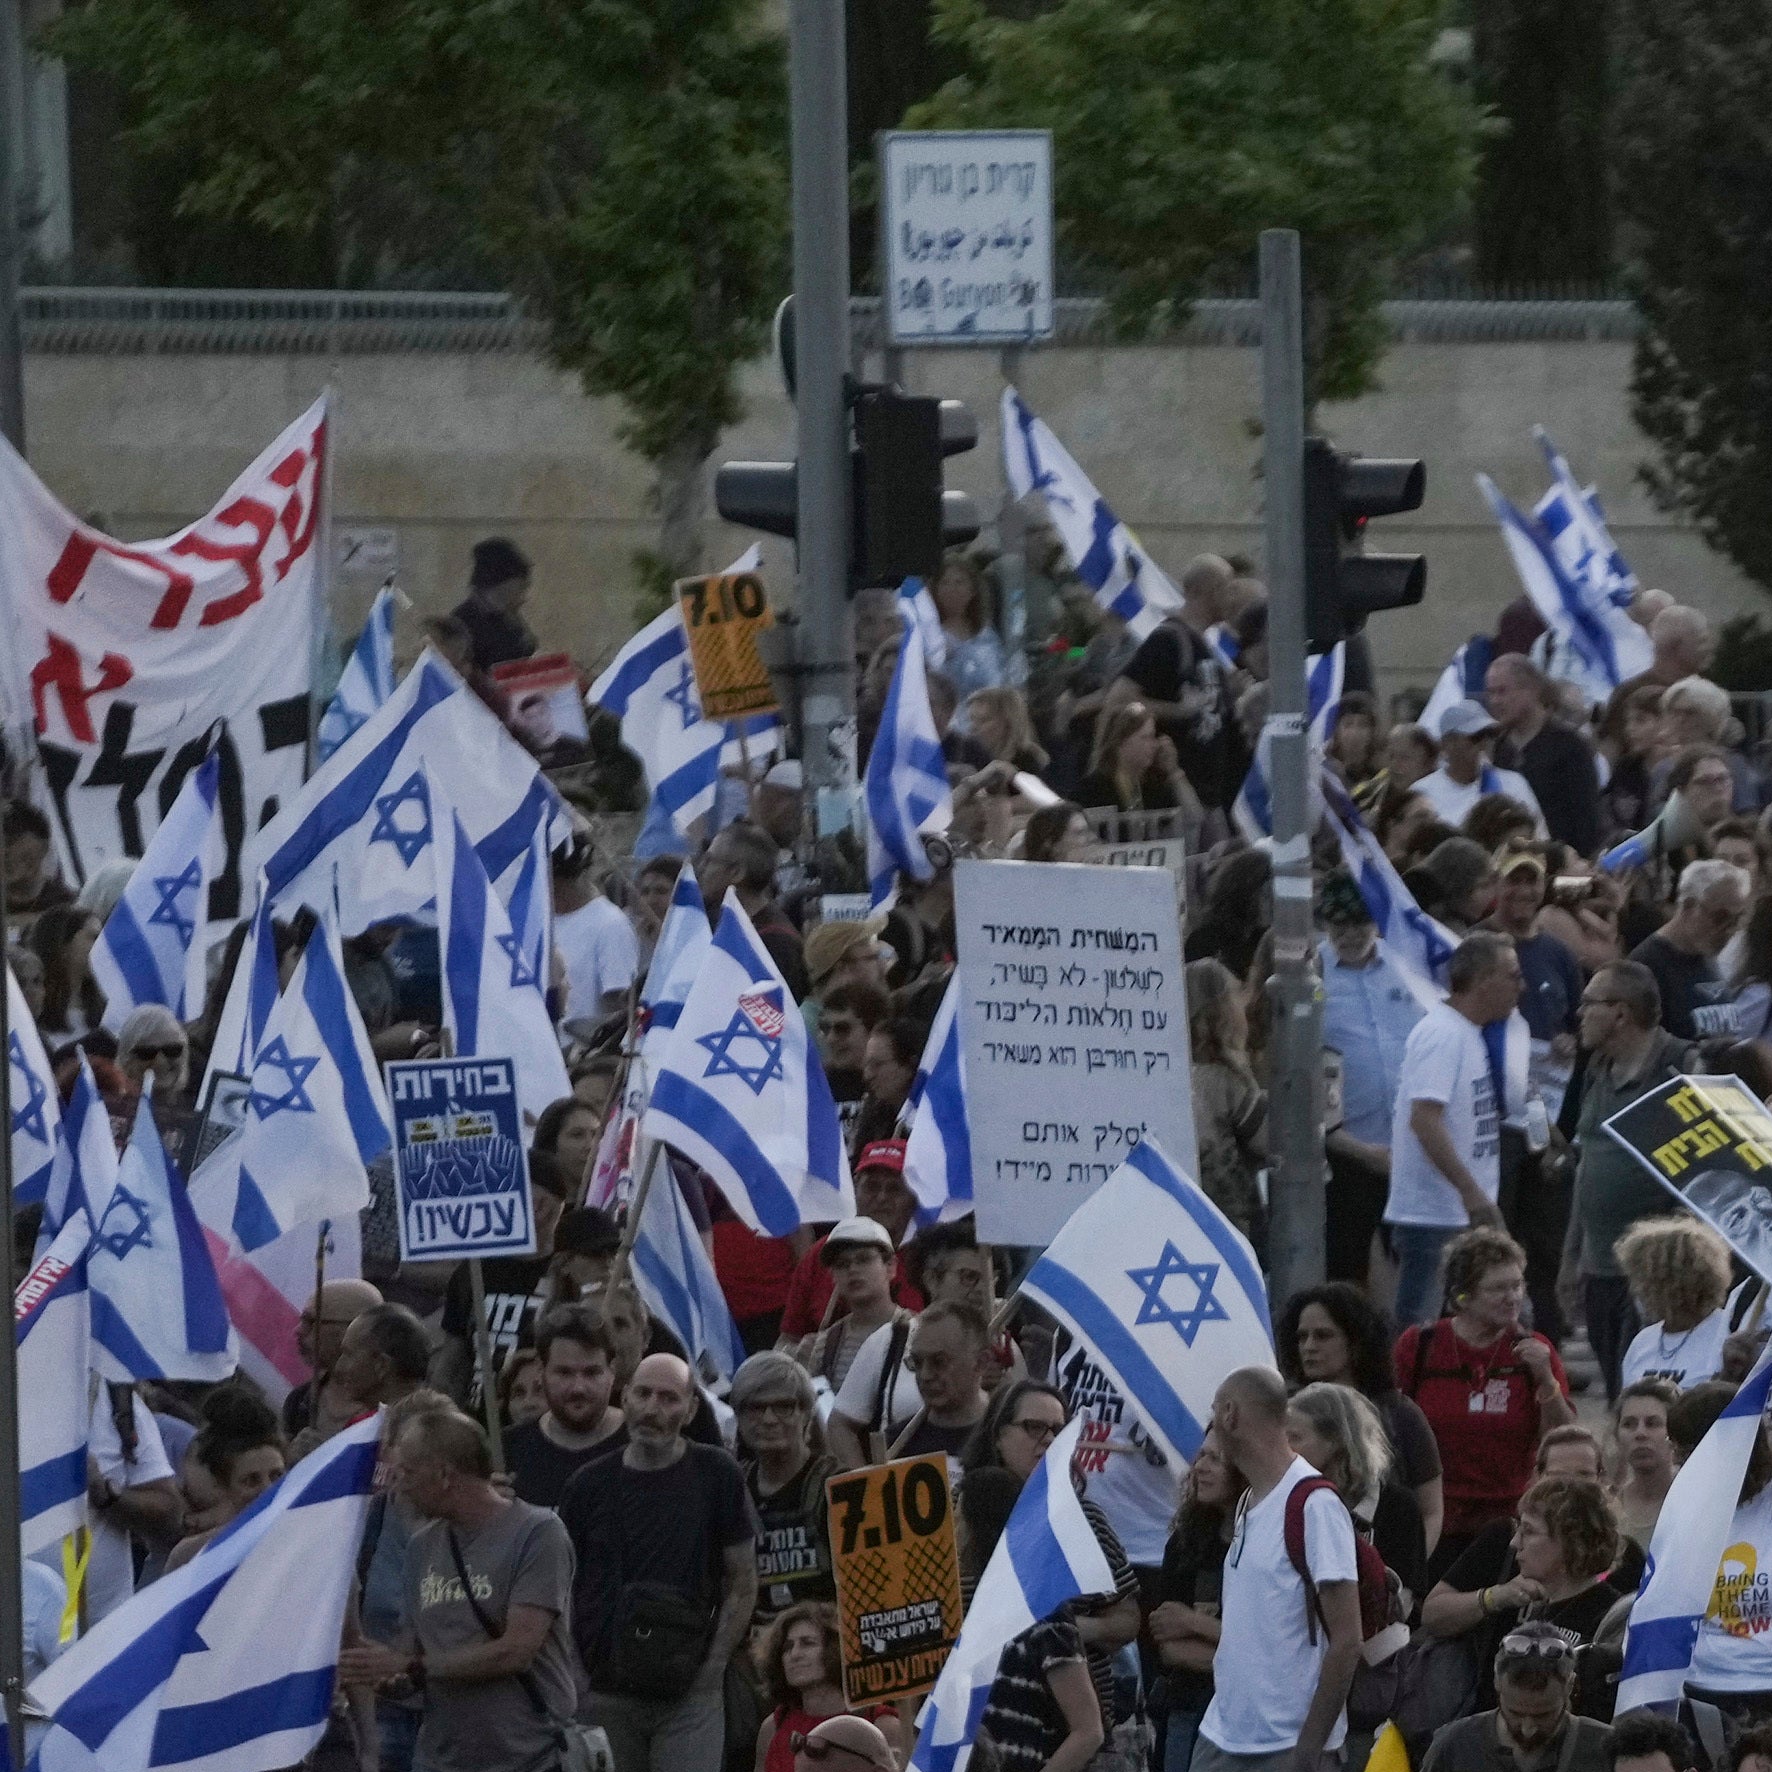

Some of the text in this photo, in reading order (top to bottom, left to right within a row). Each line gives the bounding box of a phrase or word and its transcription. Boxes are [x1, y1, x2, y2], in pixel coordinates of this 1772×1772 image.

[1142, 1008, 1168, 1032] עם
[1146, 1050, 1171, 1075] רק
[396, 1062, 512, 1101] בחירות
[1022, 1121, 1078, 1145] אותם
[413, 1204, 518, 1245] עכשיו!
[830, 1461, 949, 1552] 7.10
[1717, 1573, 1769, 1588] BRING
[1717, 1588, 1770, 1603] THEM
[1718, 1602, 1770, 1618] HOME
